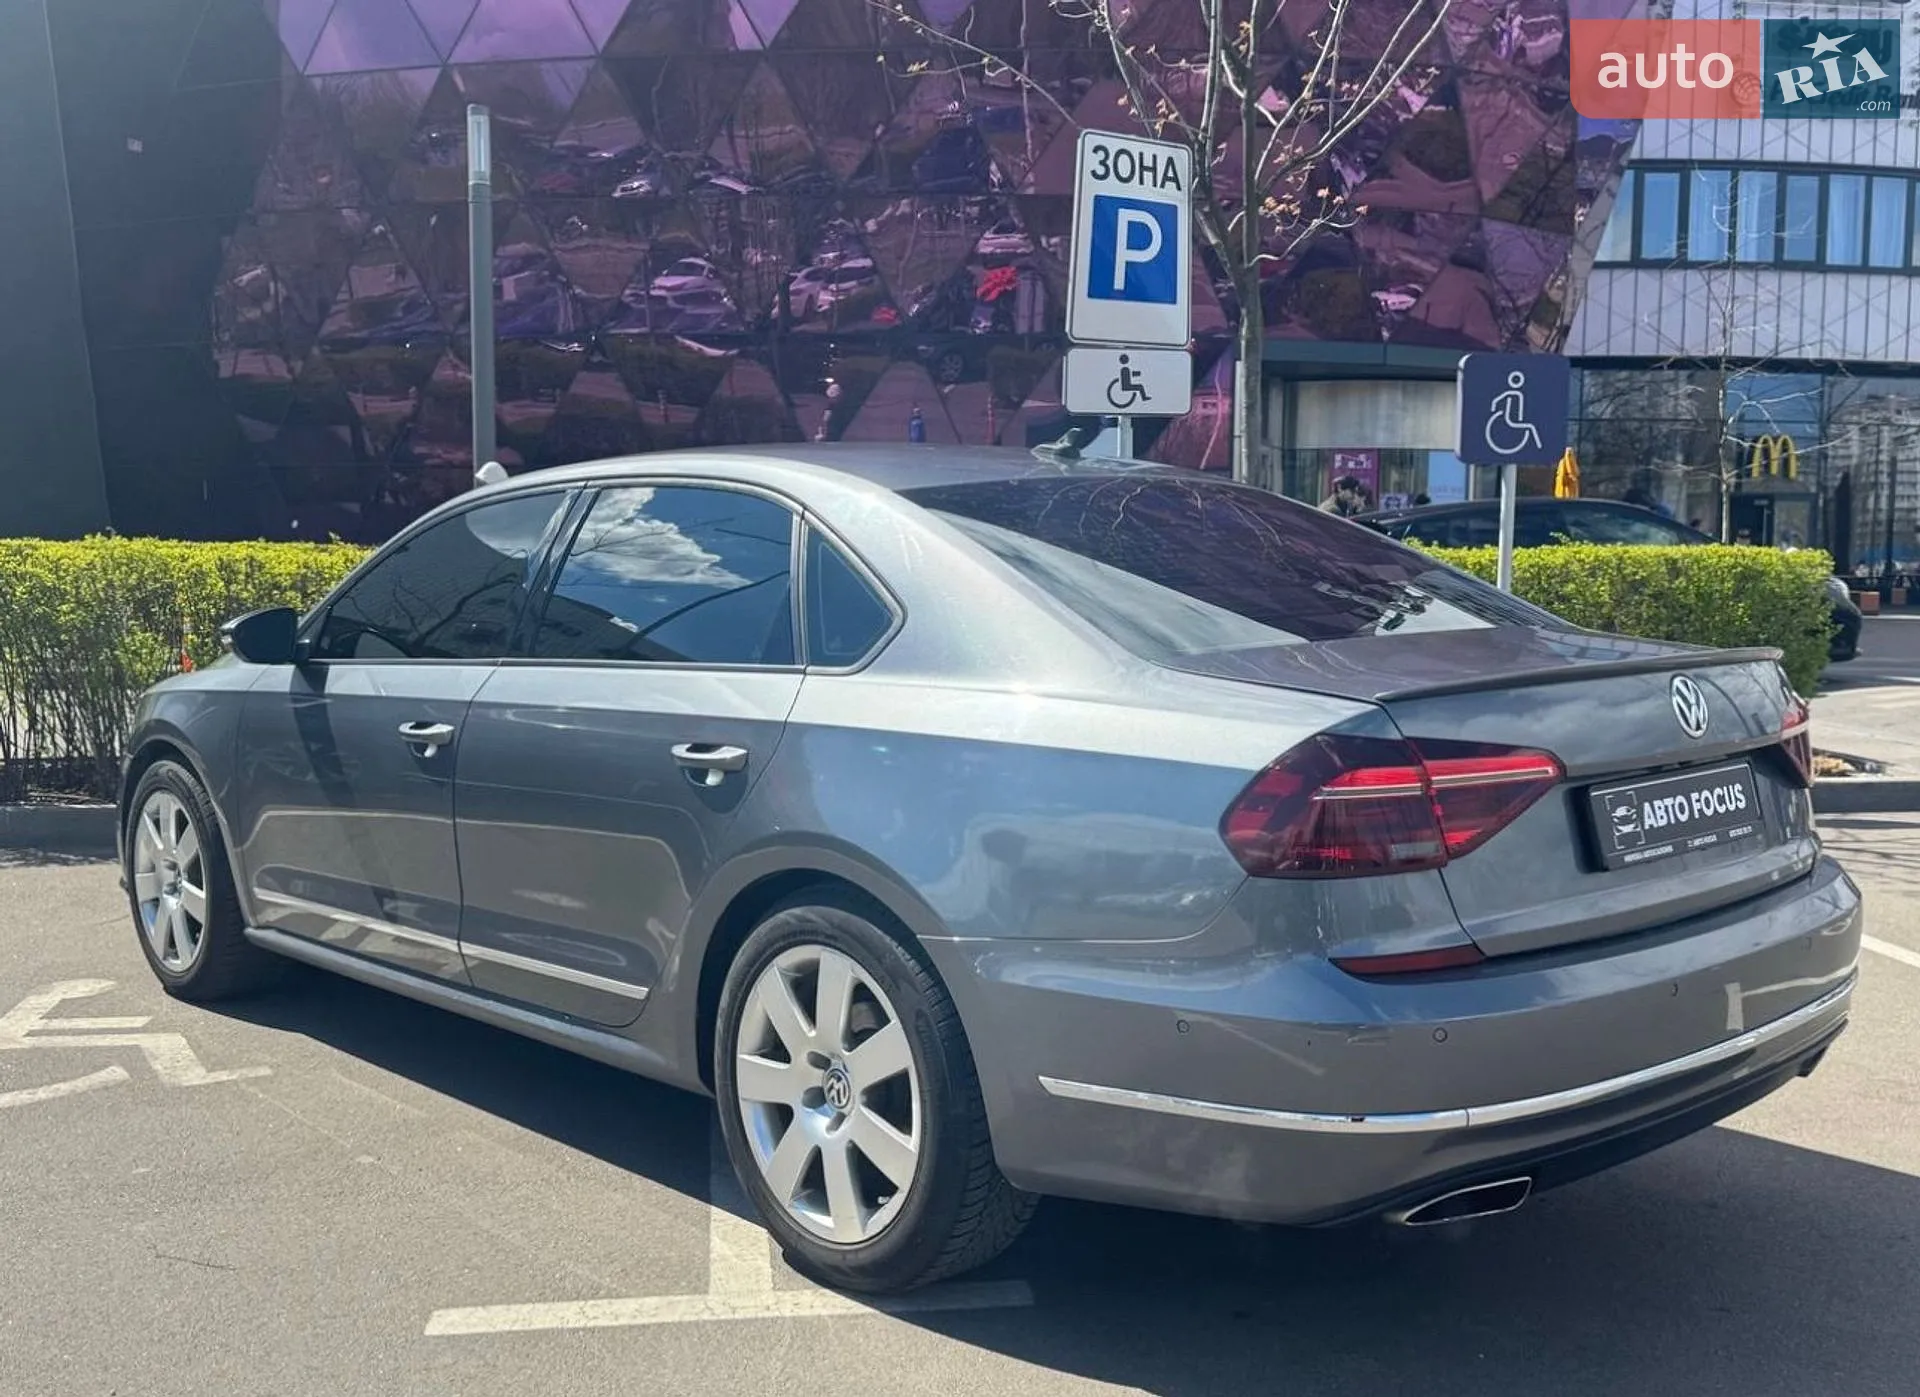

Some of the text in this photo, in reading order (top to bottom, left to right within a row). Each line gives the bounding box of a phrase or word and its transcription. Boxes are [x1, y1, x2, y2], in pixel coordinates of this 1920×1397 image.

[1090, 144, 1182, 192] ЗОНА
[1113, 207, 1163, 291] P
[1642, 783, 1747, 831] АВТО FOCUS
